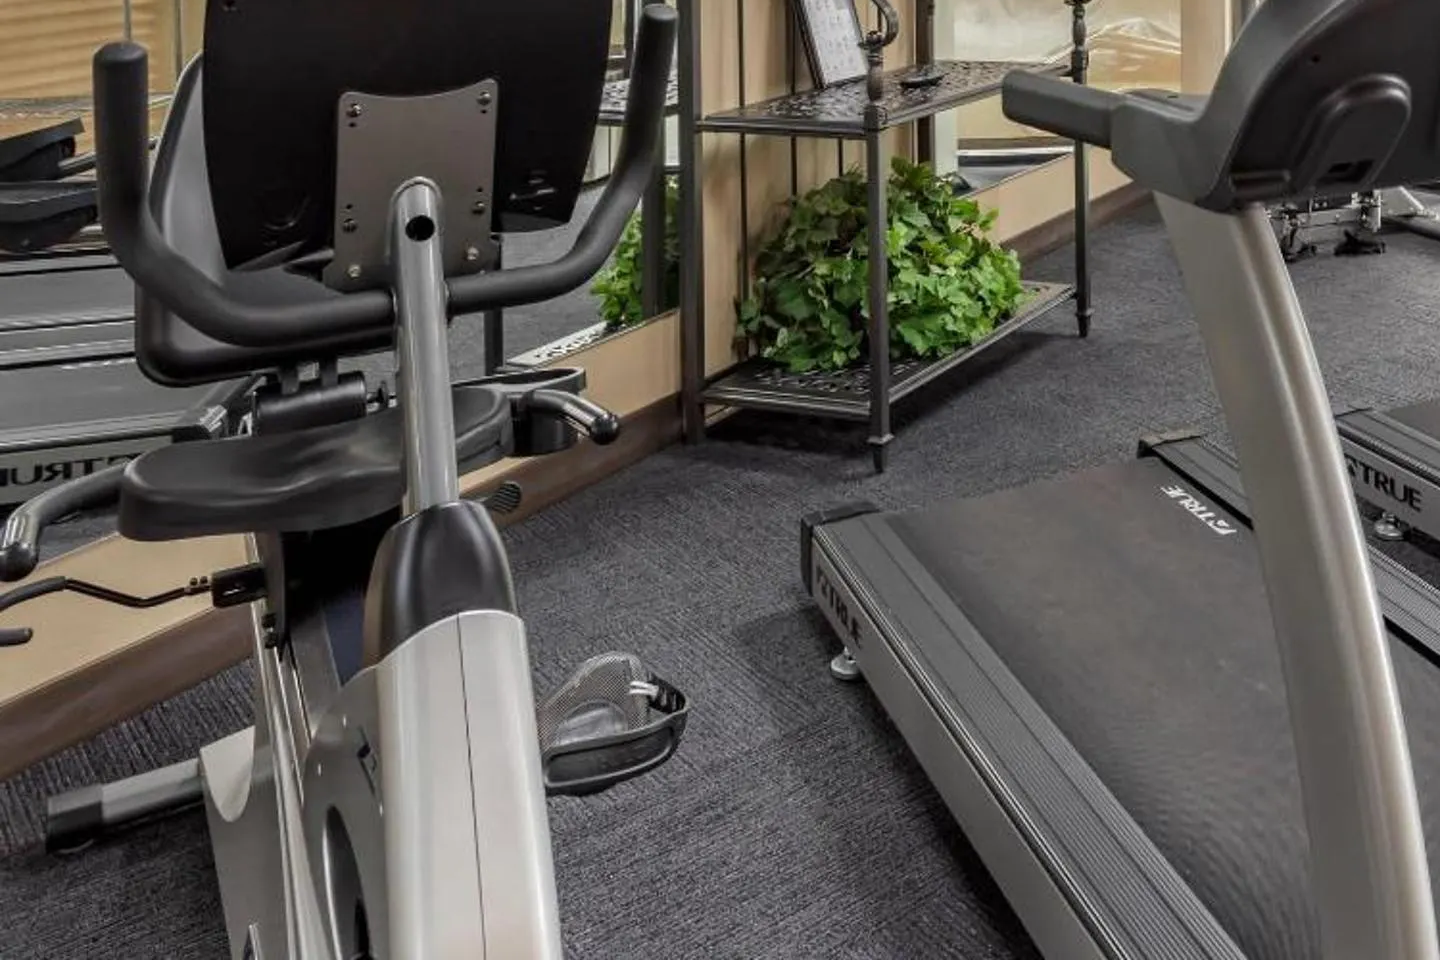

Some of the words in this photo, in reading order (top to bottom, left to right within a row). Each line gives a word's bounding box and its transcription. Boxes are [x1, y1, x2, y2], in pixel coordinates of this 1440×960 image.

[1160, 484, 1217, 524] TRUE
[1358, 461, 1422, 514] TRUE
[829, 585, 863, 651] TRUE
